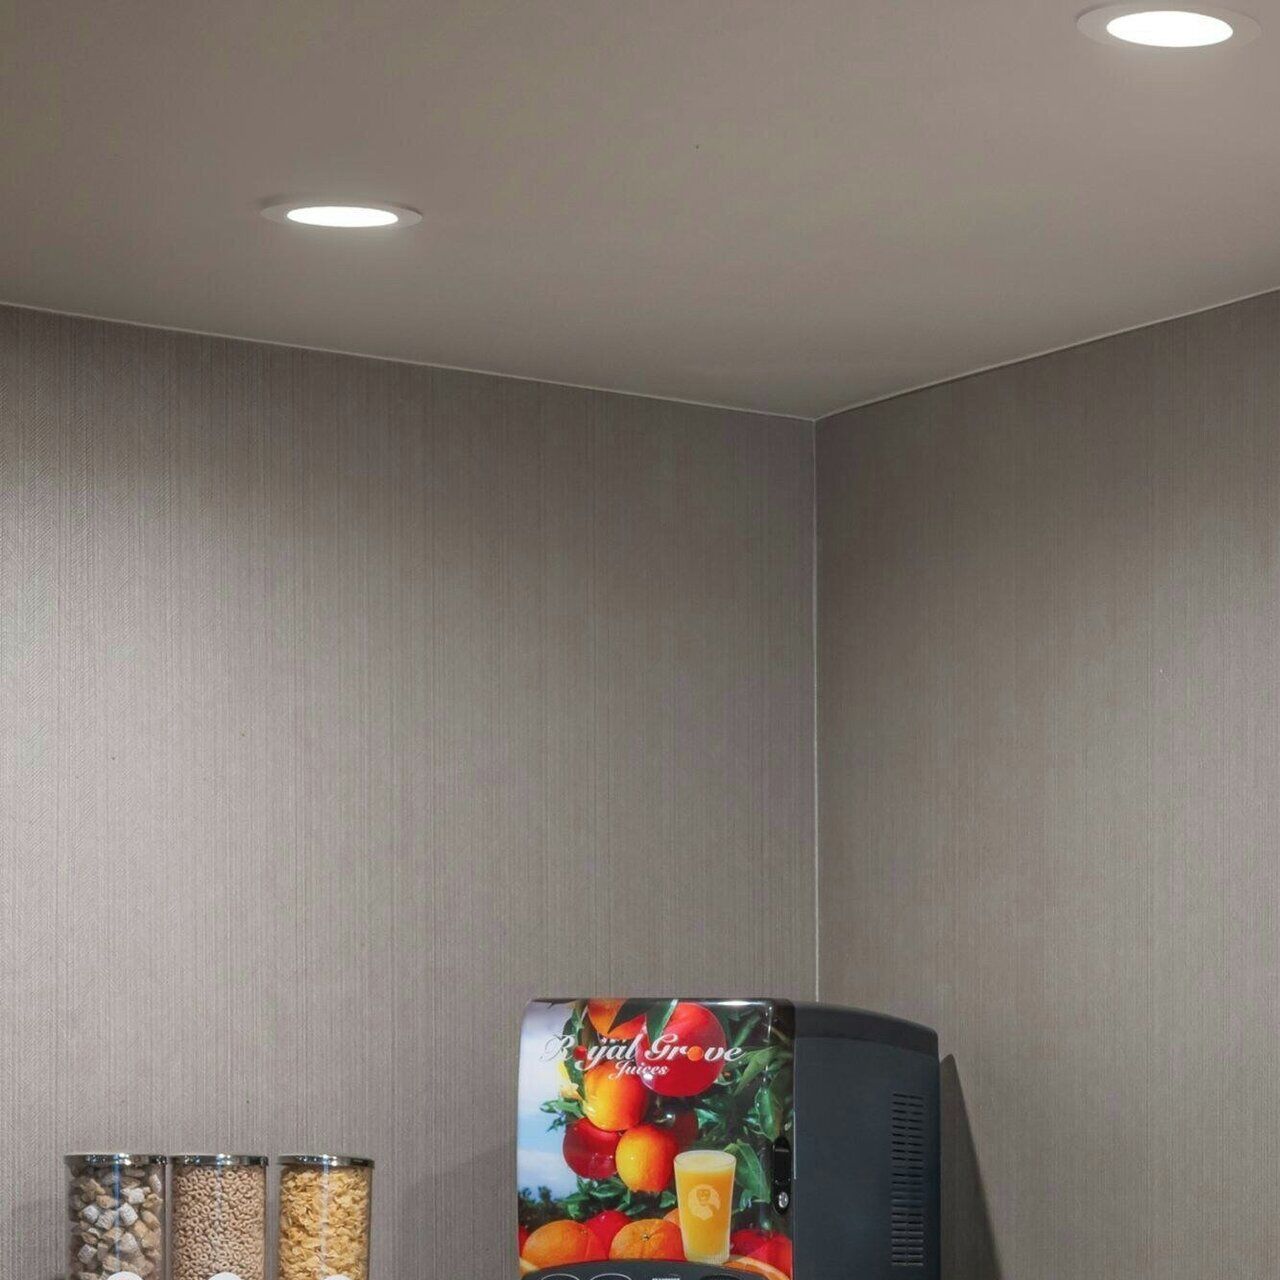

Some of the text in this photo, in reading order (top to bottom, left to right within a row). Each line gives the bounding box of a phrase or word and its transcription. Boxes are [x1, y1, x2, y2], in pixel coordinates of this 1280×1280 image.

[539, 1033, 746, 1070] Royal Grove
[608, 1060, 669, 1080] Juices
